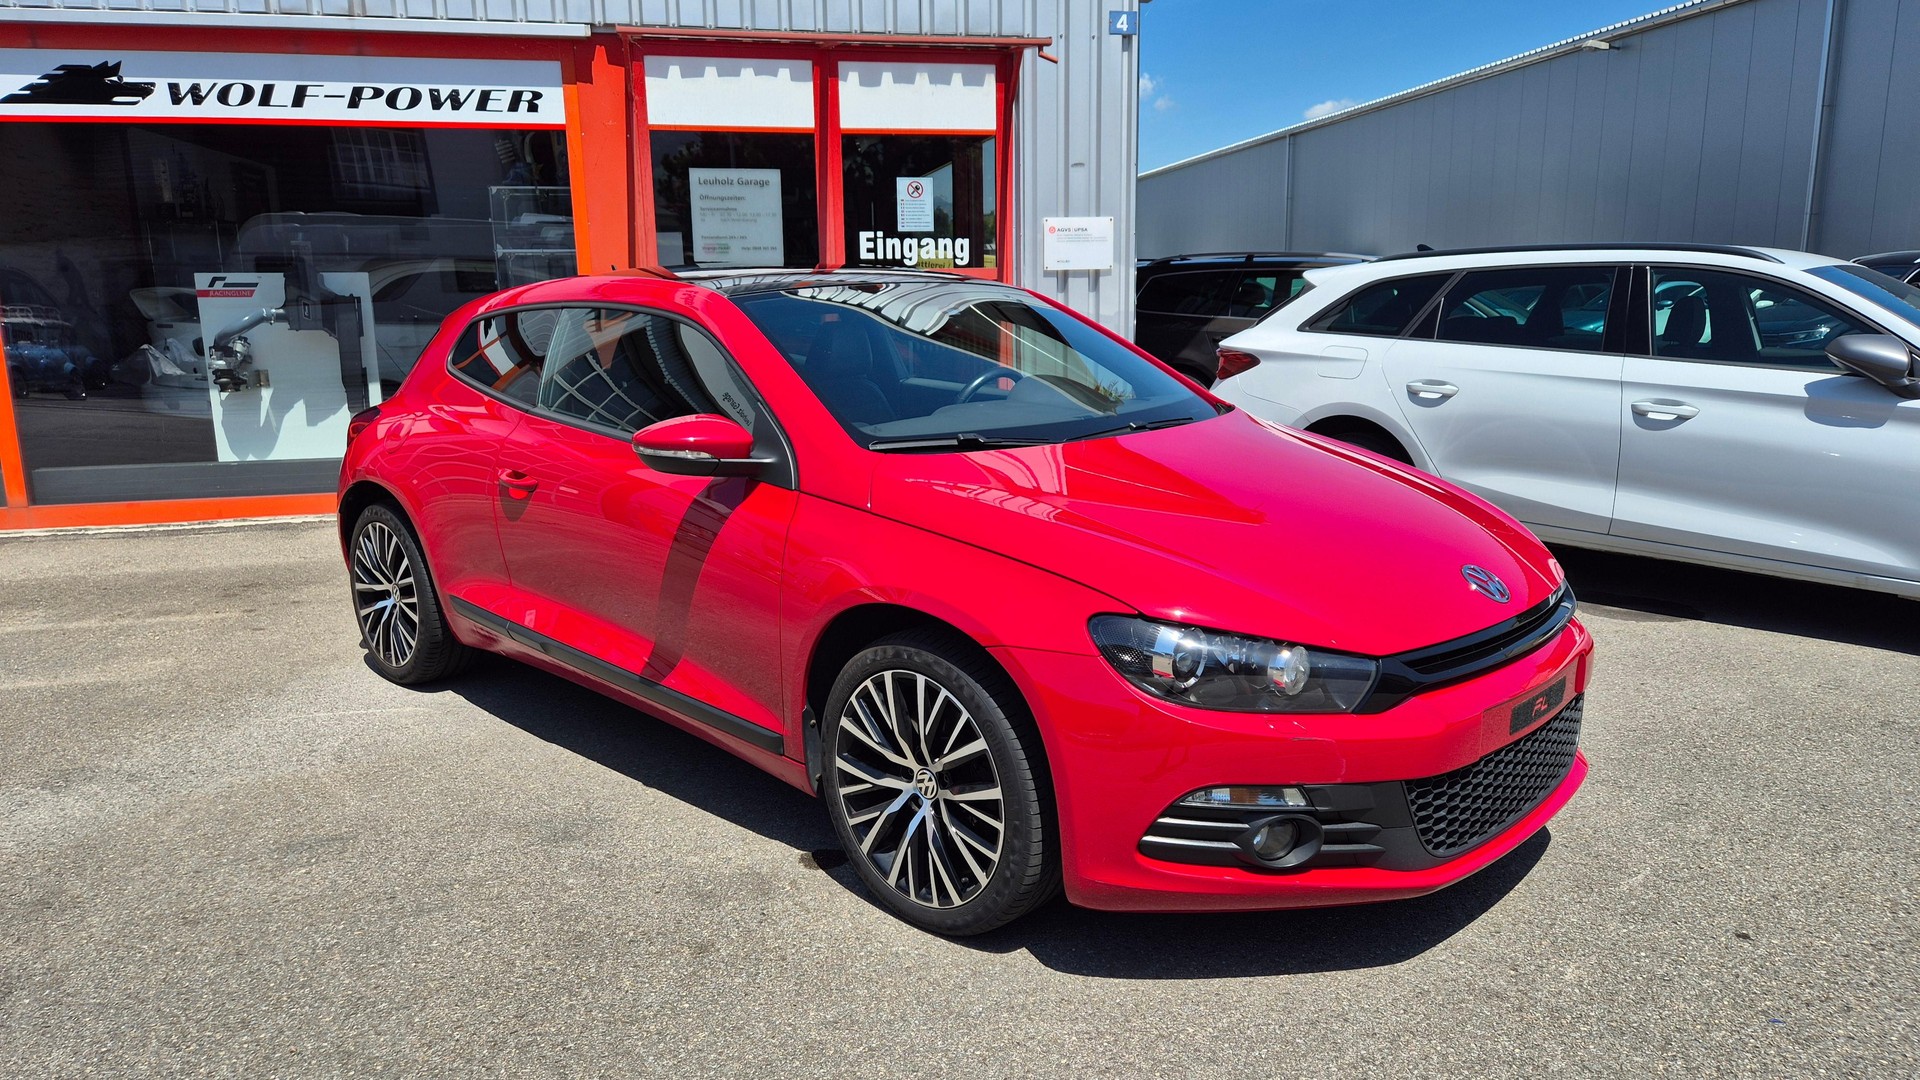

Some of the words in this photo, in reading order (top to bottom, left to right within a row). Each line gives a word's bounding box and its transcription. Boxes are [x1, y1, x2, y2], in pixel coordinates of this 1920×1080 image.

[1116, 13, 1128, 32] 4
[167, 81, 543, 113] WOLF-POWER
[698, 177, 734, 186] Leuholz
[737, 177, 770, 187] Garage
[859, 231, 970, 266] Eingang
